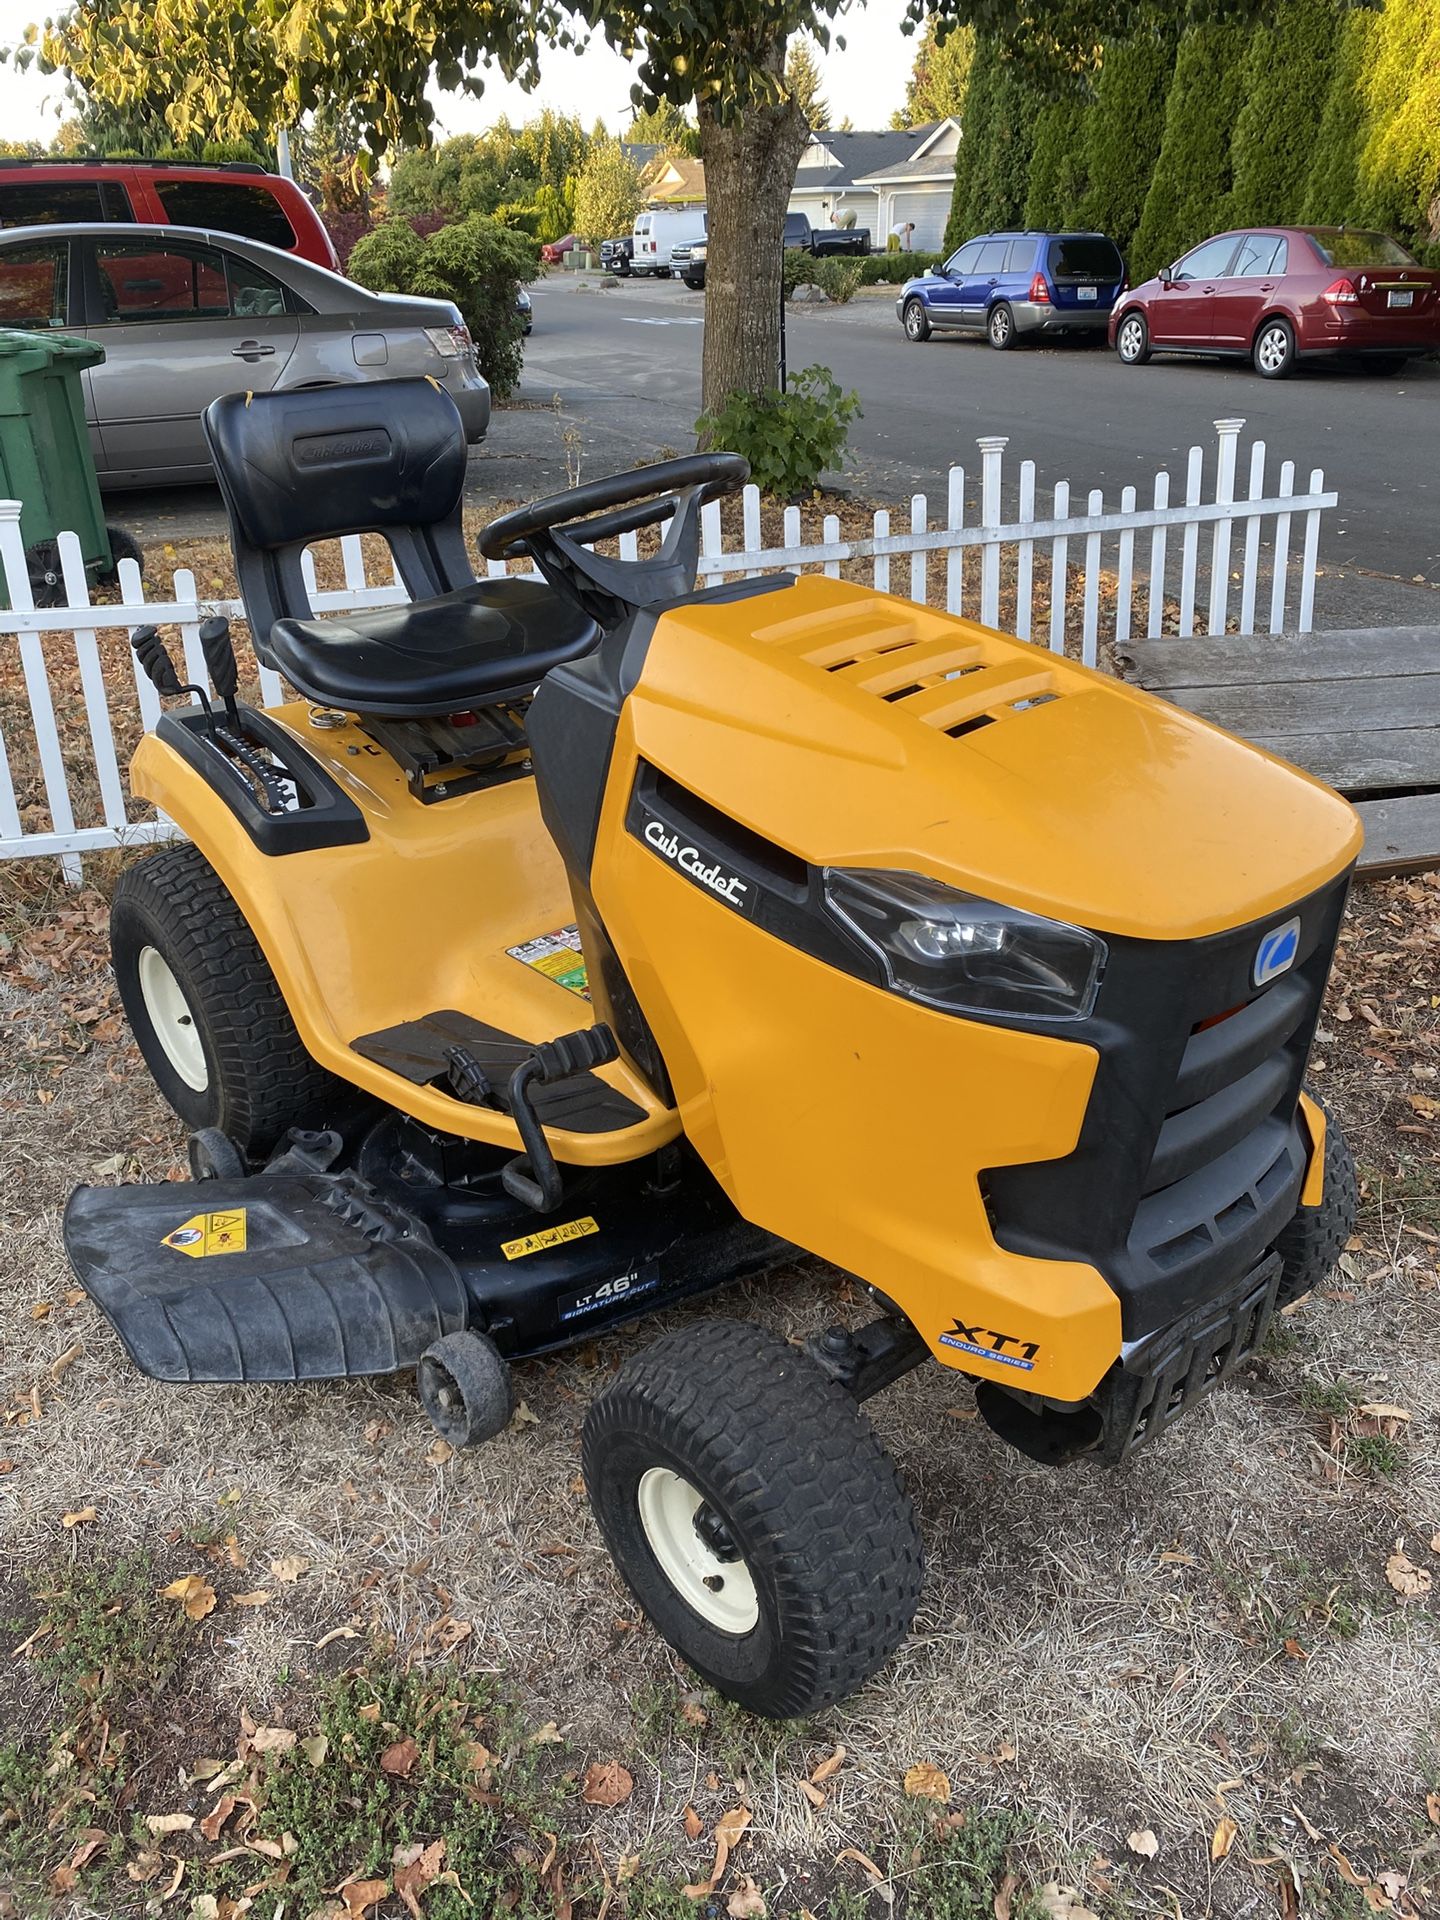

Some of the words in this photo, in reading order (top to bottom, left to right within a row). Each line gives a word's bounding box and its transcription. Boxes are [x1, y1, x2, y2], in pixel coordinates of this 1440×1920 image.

[644, 821, 679, 860] Cub
[564, 1293, 626, 1320] SIGNATURE
[576, 1295, 593, 1308] LT
[595, 1272, 638, 1299] 46"
[940, 1335, 986, 1356] ENDURO
[943, 1317, 1040, 1361] XT1
